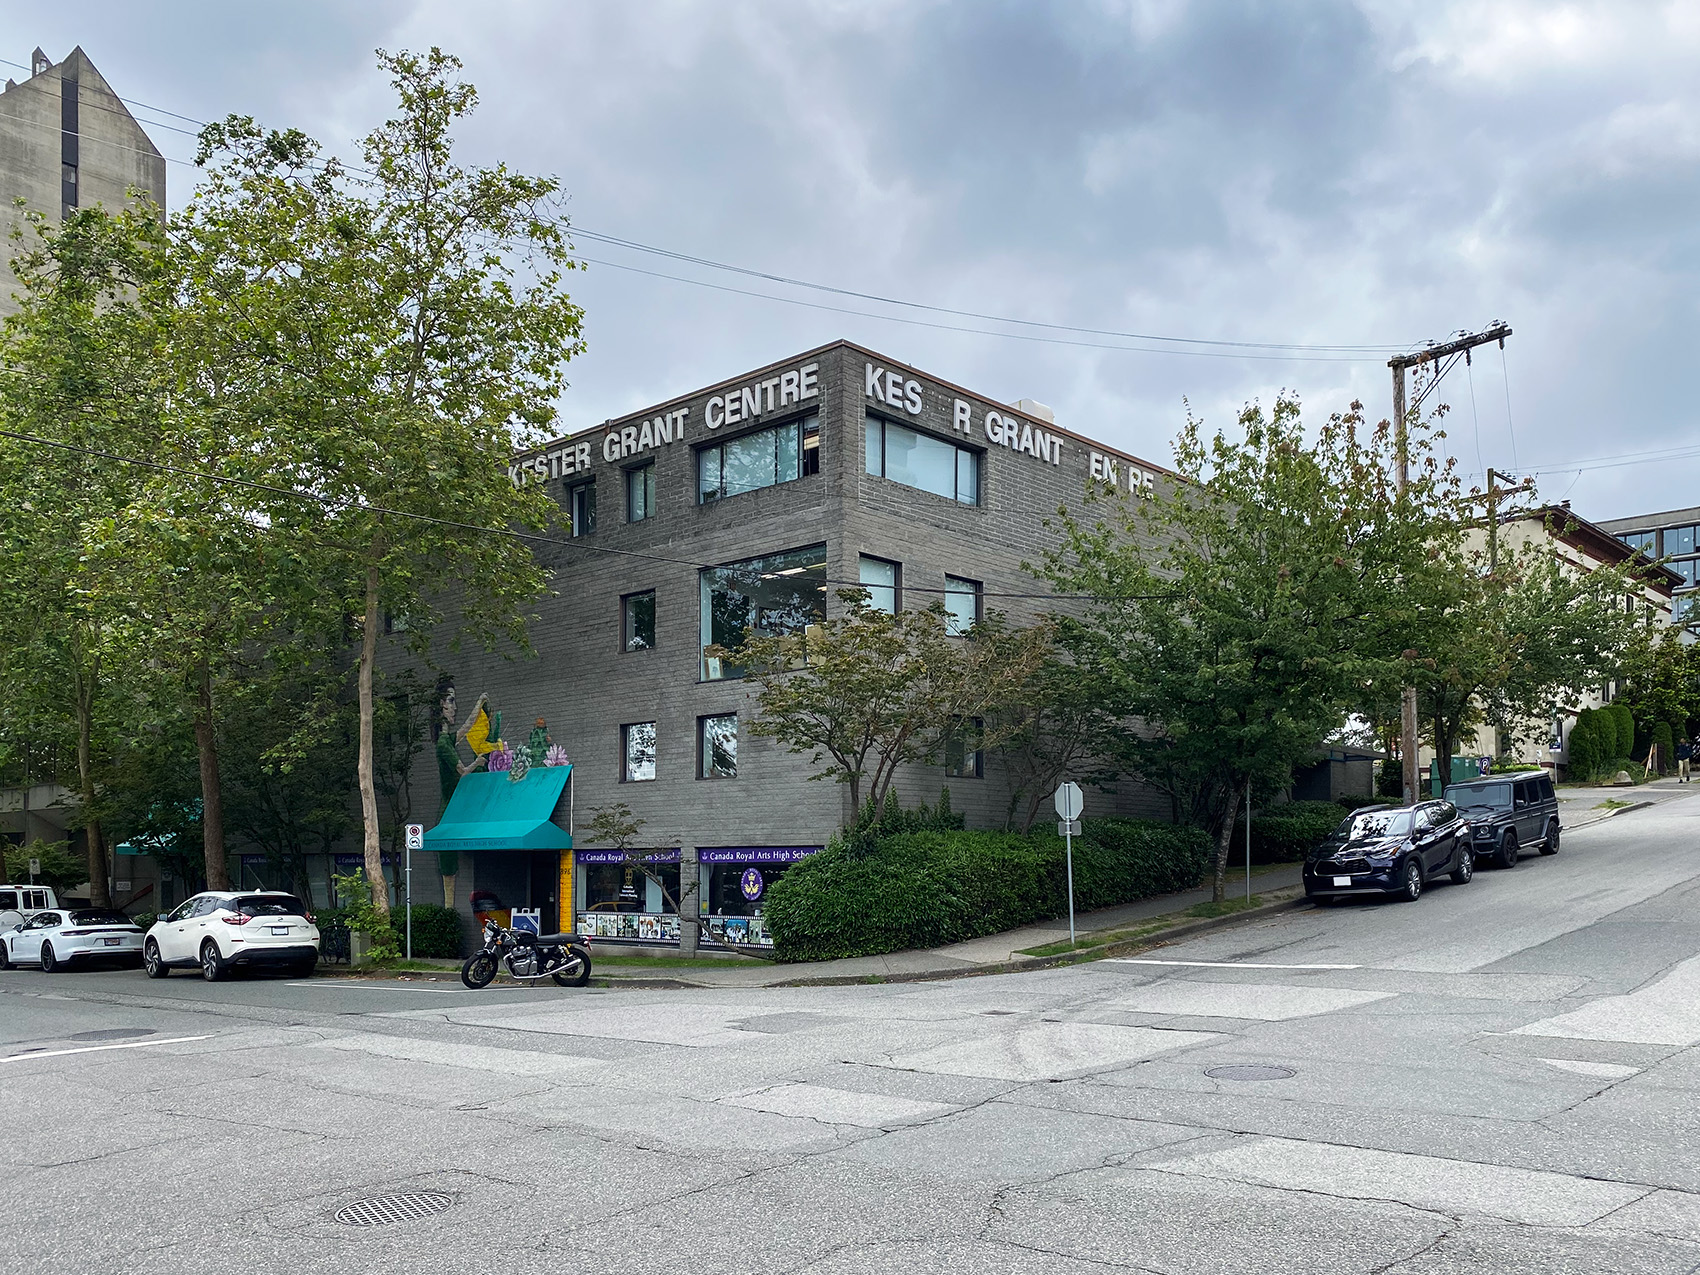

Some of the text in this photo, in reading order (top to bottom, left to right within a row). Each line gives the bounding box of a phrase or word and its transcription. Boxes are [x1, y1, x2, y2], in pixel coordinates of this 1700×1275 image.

[508, 363, 818, 490] KESTER GRANT CENTRE
[865, 363, 923, 415] KES
[953, 398, 971, 434] R
[985, 411, 1064, 466] GRANT
[586, 853, 606, 861] Canada
[607, 853, 624, 863] Royal
[709, 851, 734, 861] Canada
[736, 851, 755, 862] Royal
[757, 851, 771, 860] Arts
[773, 850, 790, 862] High
